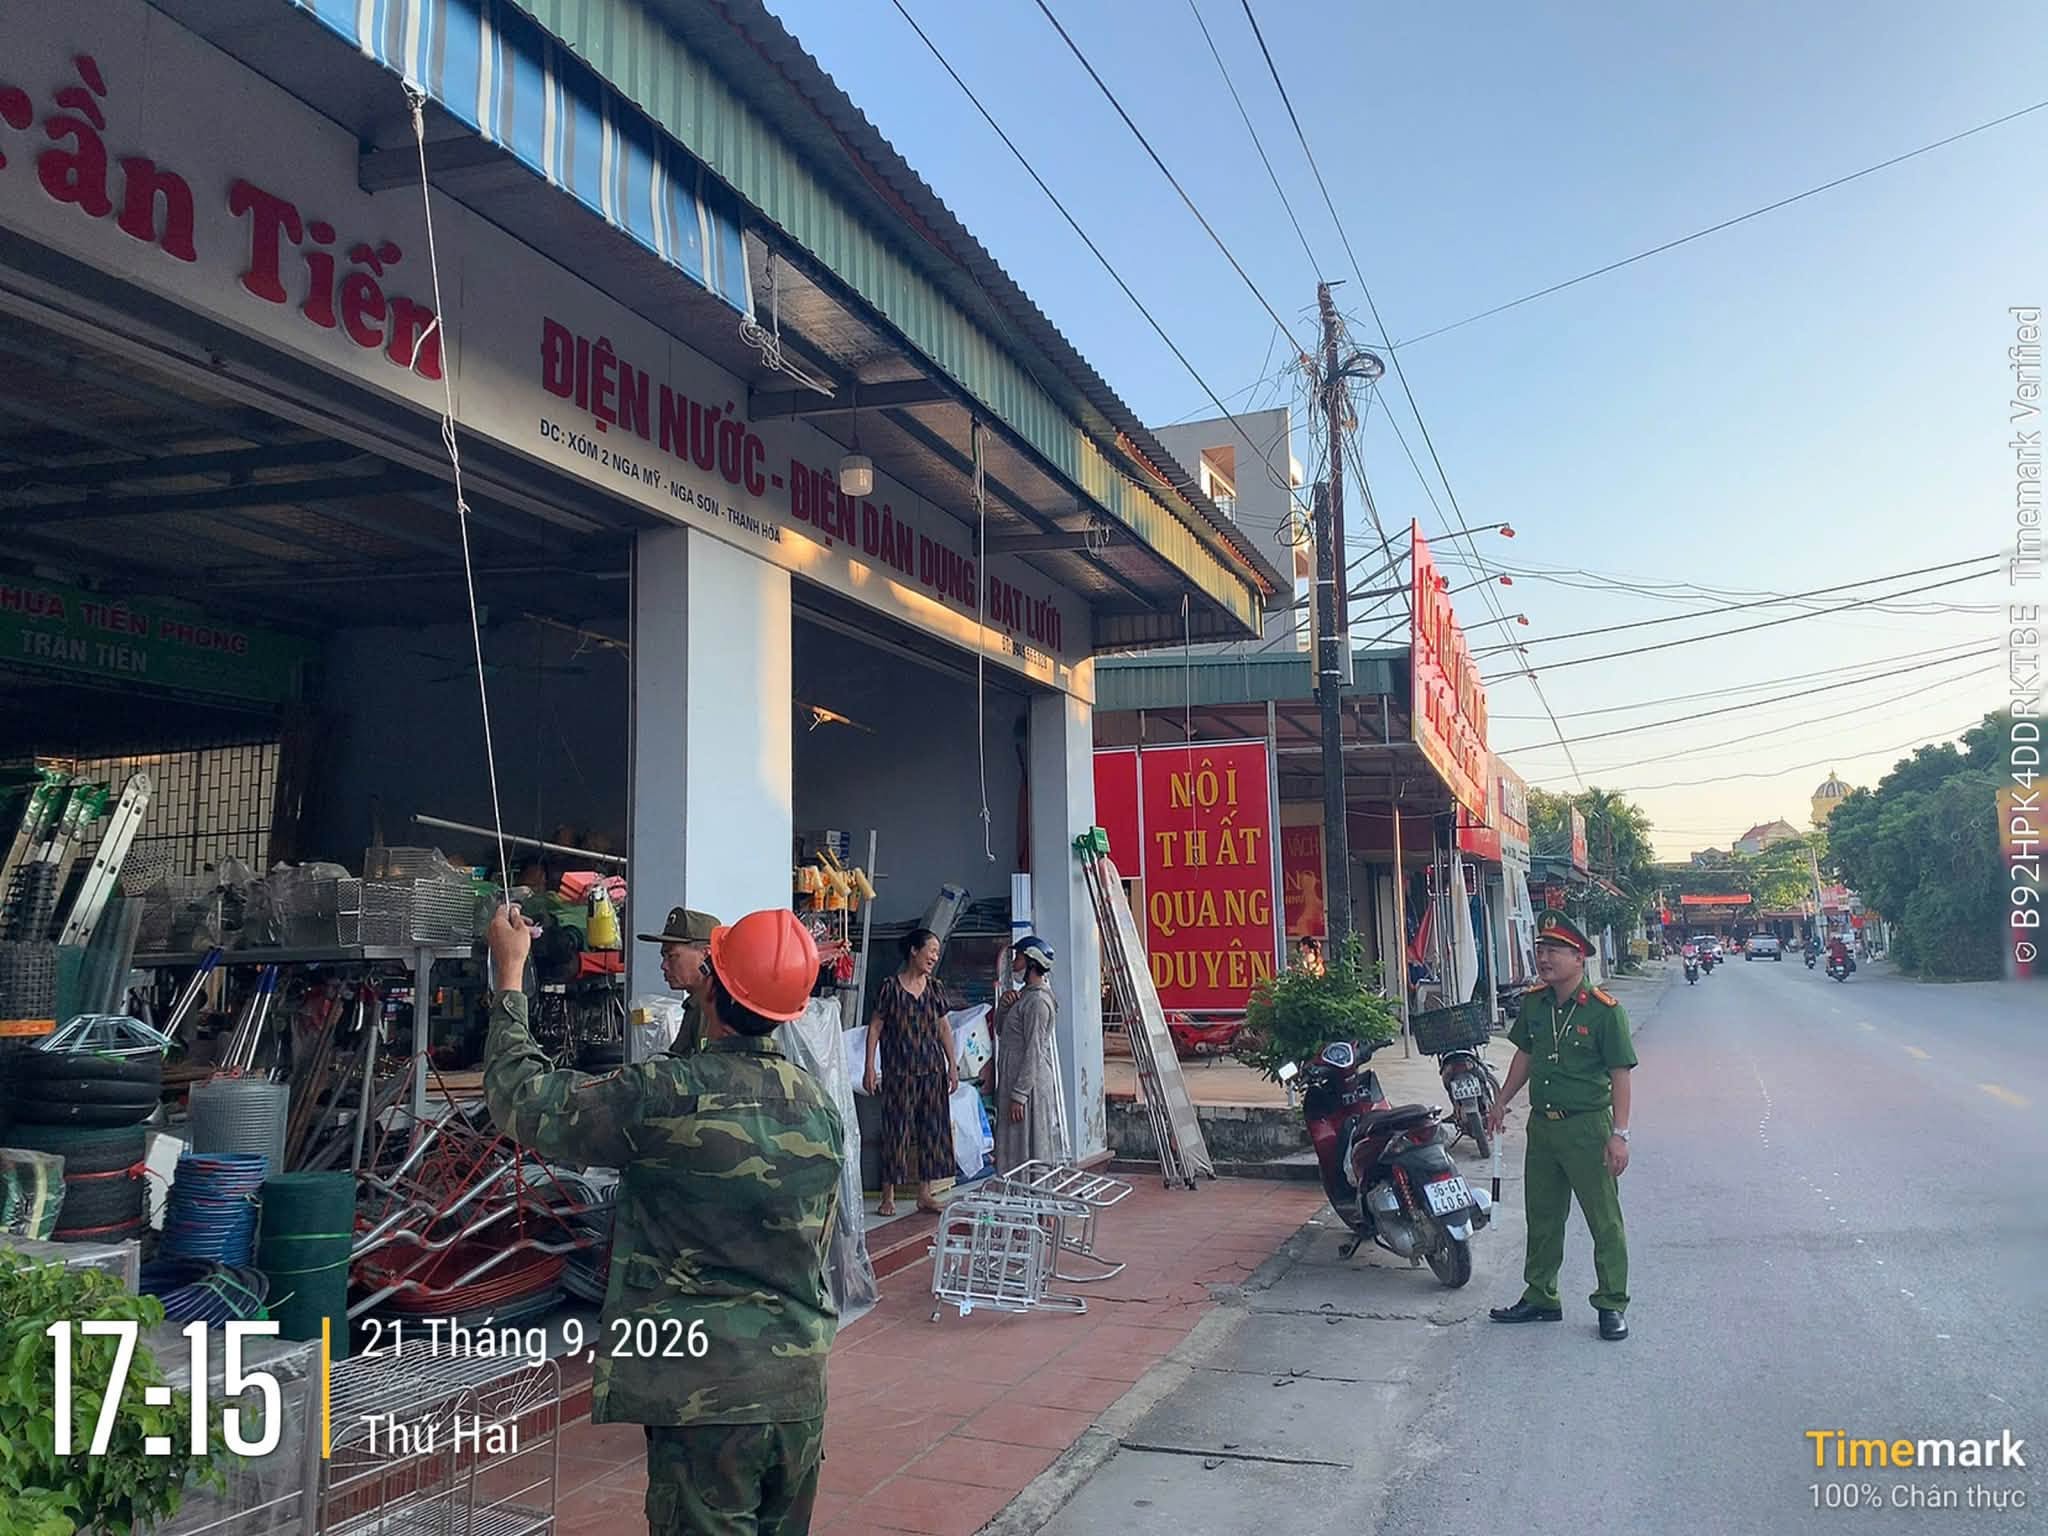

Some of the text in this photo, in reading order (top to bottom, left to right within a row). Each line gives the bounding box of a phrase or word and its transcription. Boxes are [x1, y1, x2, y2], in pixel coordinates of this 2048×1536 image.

[0, 54, 442, 380] ần Tiến
[541, 316, 651, 441] ĐIỆN
[659, 383, 766, 497] NƯỚC
[791, 458, 857, 548] ĐIỆN
[863, 501, 914, 577] DÂN
[919, 534, 977, 609] DỤNG
[990, 575, 1023, 637] BẠT
[1025, 593, 1062, 653] LƯỚI
[568, 430, 599, 462] XÓM
[602, 449, 609, 467] 2
[612, 453, 640, 479] NGA
[670, 480, 695, 506] NGA
[727, 507, 760, 536] THANH
[160, 616, 249, 656] PHONG
[1155, 810, 1262, 868] THẤT
[1150, 888, 1270, 937] QUANG
[1151, 938, 1273, 989] DUYÊN
